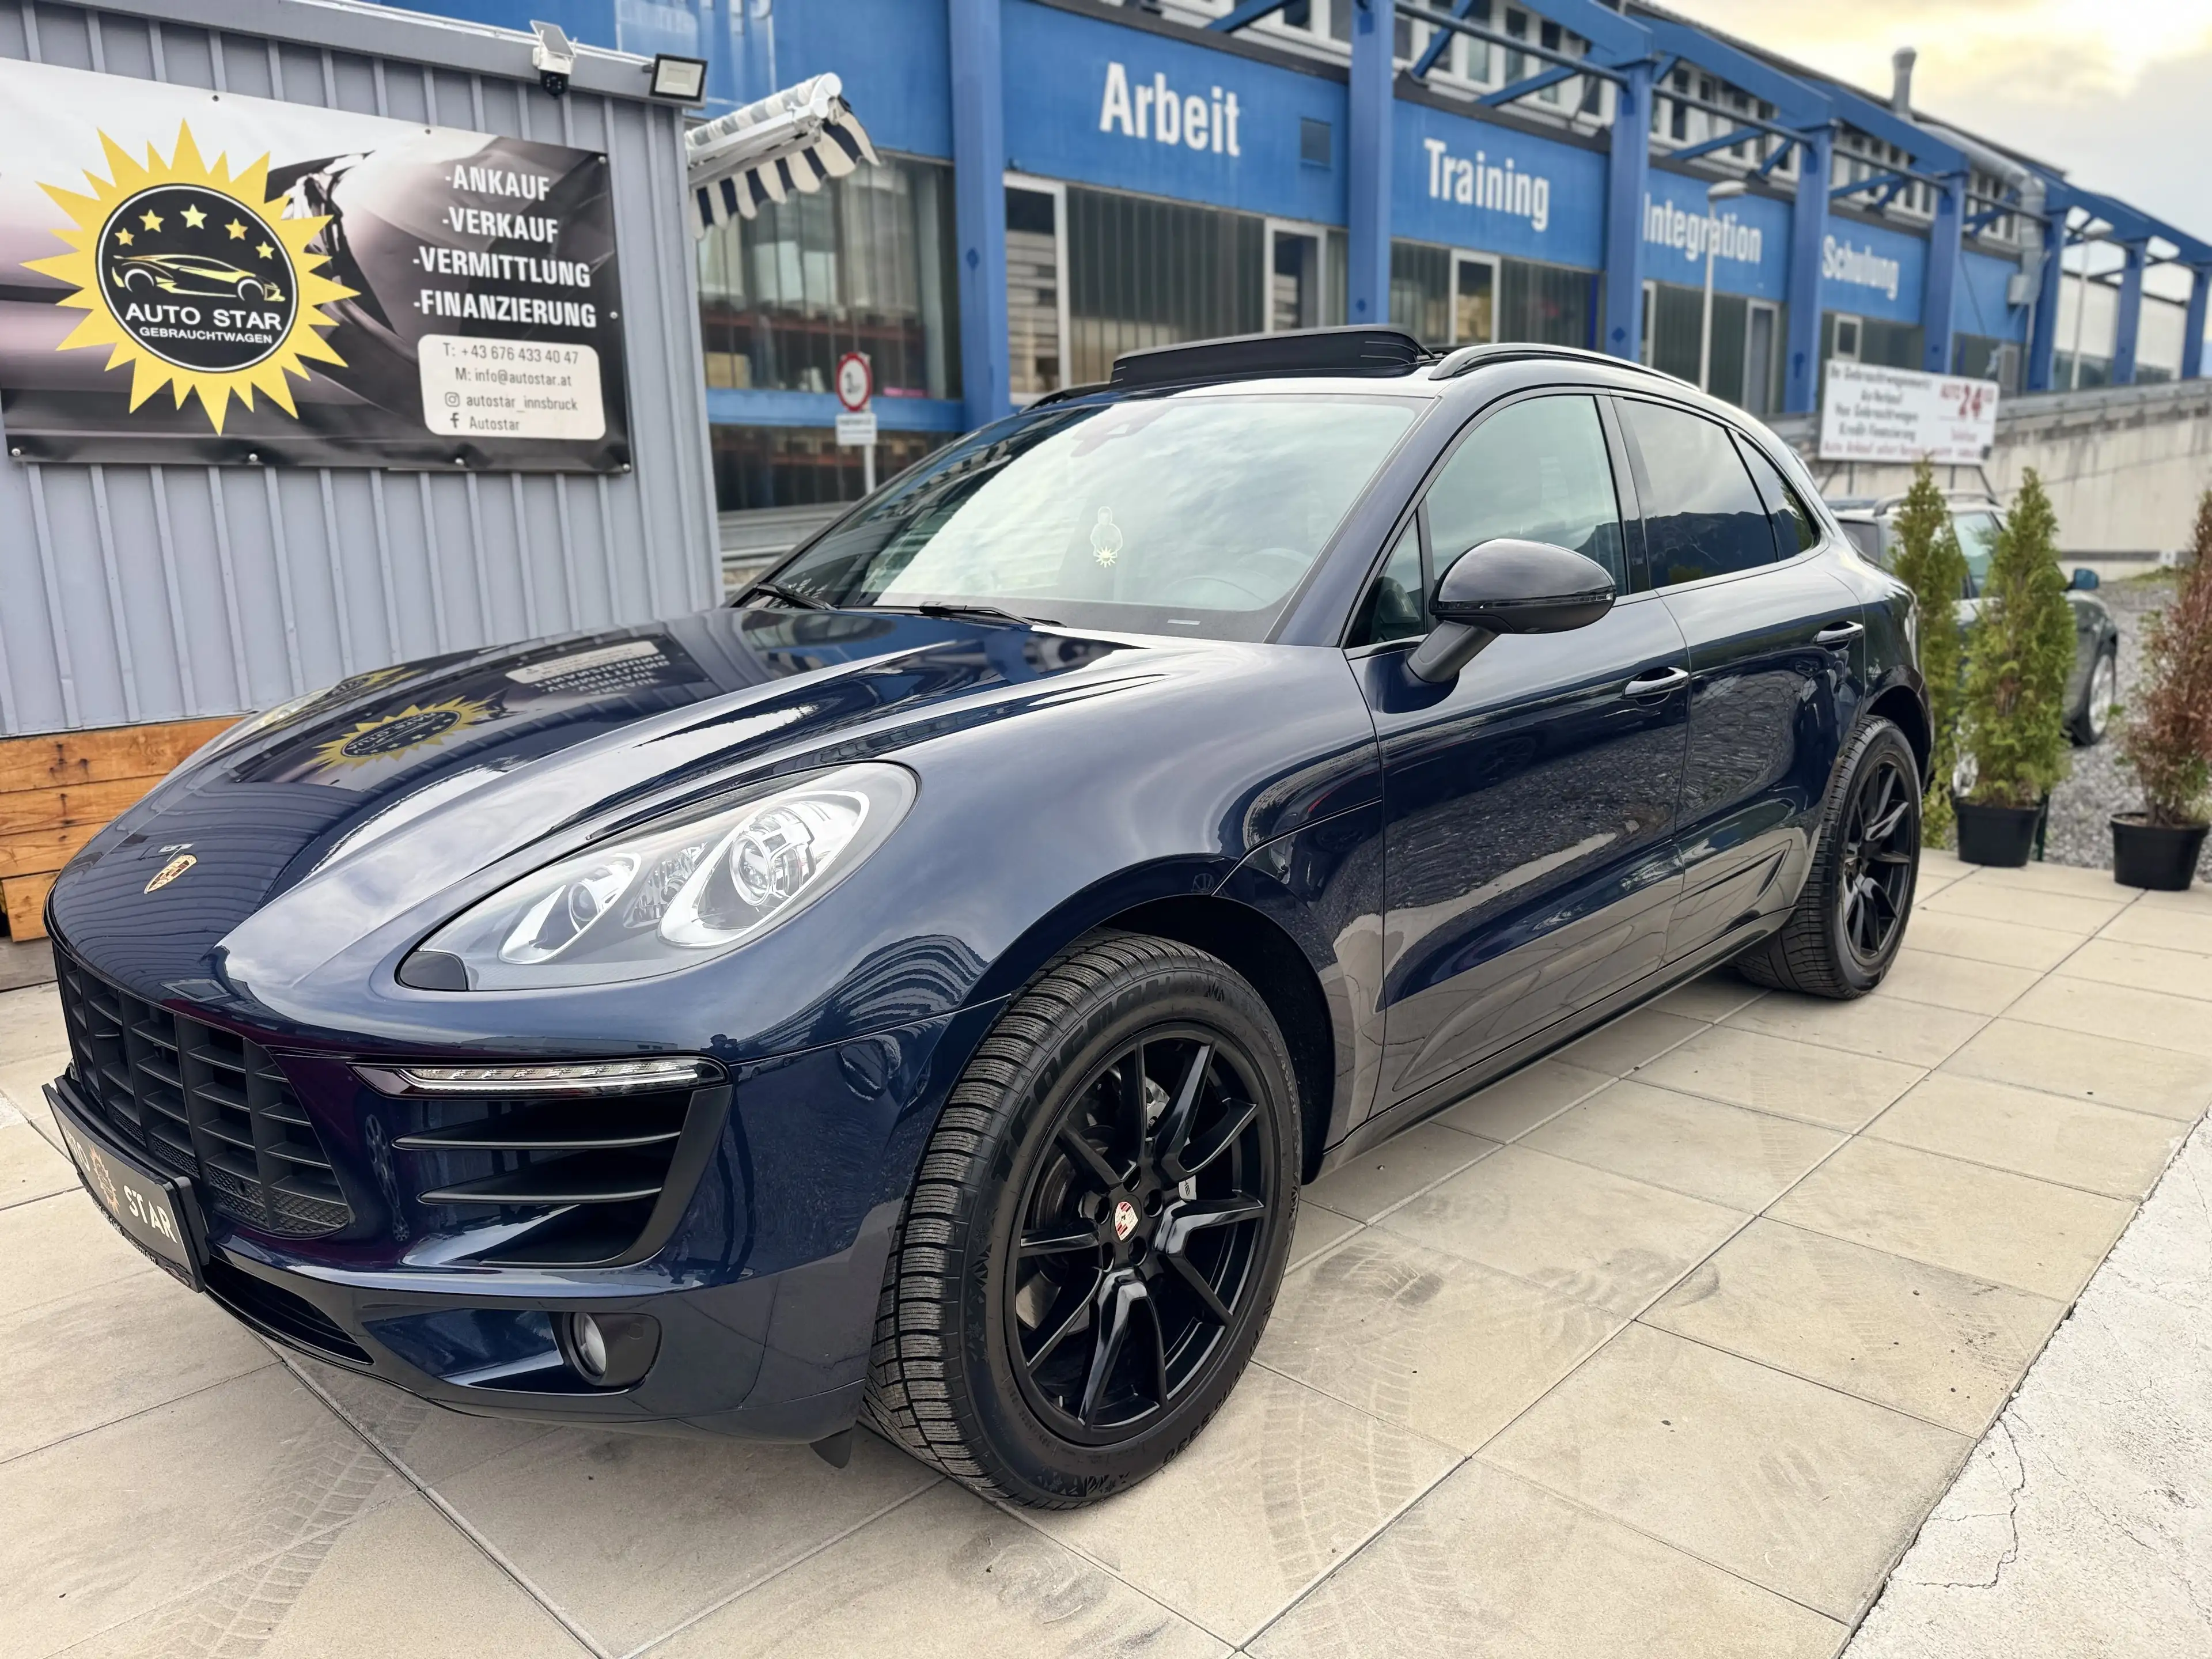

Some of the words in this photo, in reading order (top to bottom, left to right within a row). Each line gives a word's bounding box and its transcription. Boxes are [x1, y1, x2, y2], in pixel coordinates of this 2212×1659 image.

[1099, 61, 1241, 157] Arbeit
[445, 165, 550, 201] -ANKAUF
[1424, 138, 1550, 232] Training
[442, 206, 558, 243] -VERKAUF
[1643, 192, 1762, 264] Integration
[413, 246, 591, 287] -VERMITTLUNG
[125, 302, 201, 325] AUTO
[213, 308, 282, 331] STAR
[414, 289, 597, 328] -FINANZIERUNG
[139, 327, 272, 344] GEBRAUCHTWAGEN
[442, 342, 456, 357] T:
[461, 345, 487, 359] +43
[491, 346, 514, 361] 676
[518, 348, 541, 362] 433
[545, 350, 560, 364] 40
[564, 351, 579, 365] 47
[455, 367, 472, 381] M:
[475, 368, 572, 387] info@autostar.at
[466, 395, 578, 412] autostar_innsbruck
[469, 416, 520, 431] Autostar
[123, 1185, 178, 1244] STAR
